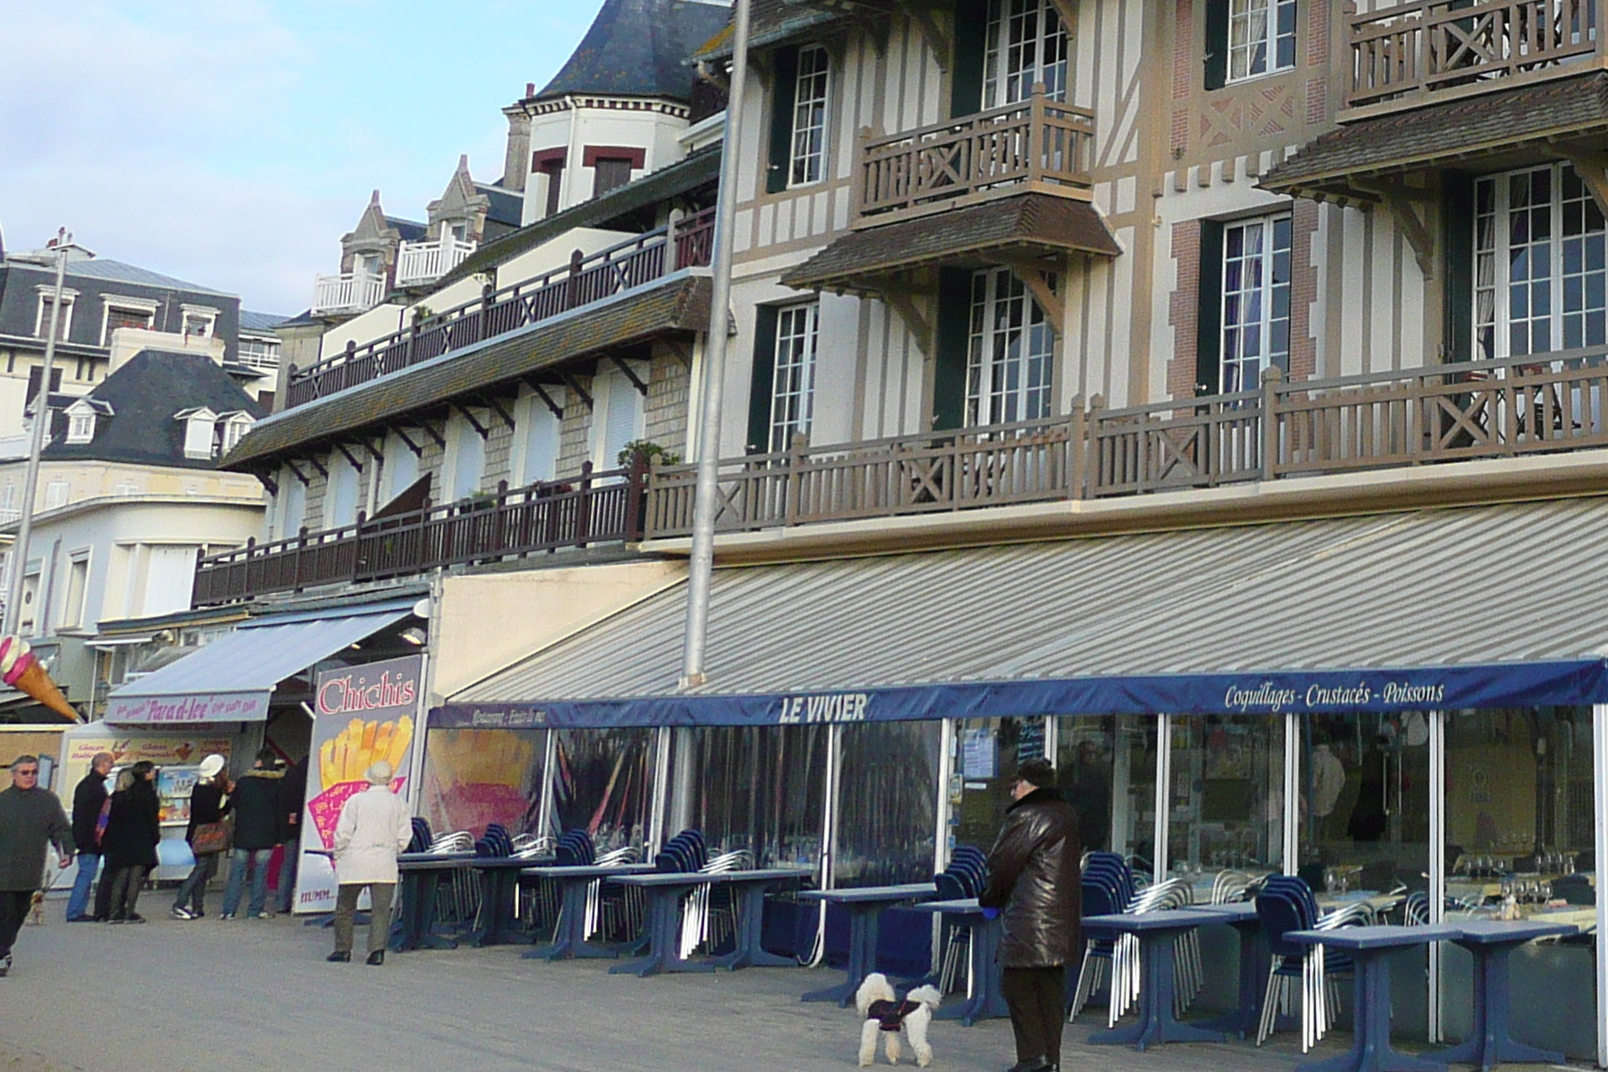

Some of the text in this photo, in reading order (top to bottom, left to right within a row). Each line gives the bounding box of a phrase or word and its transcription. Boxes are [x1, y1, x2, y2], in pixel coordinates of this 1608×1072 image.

[318, 670, 416, 715] Chichis
[779, 693, 868, 724] LE VIVIER
[1225, 680, 1445, 712] Coquillages Crustacés Poissons
